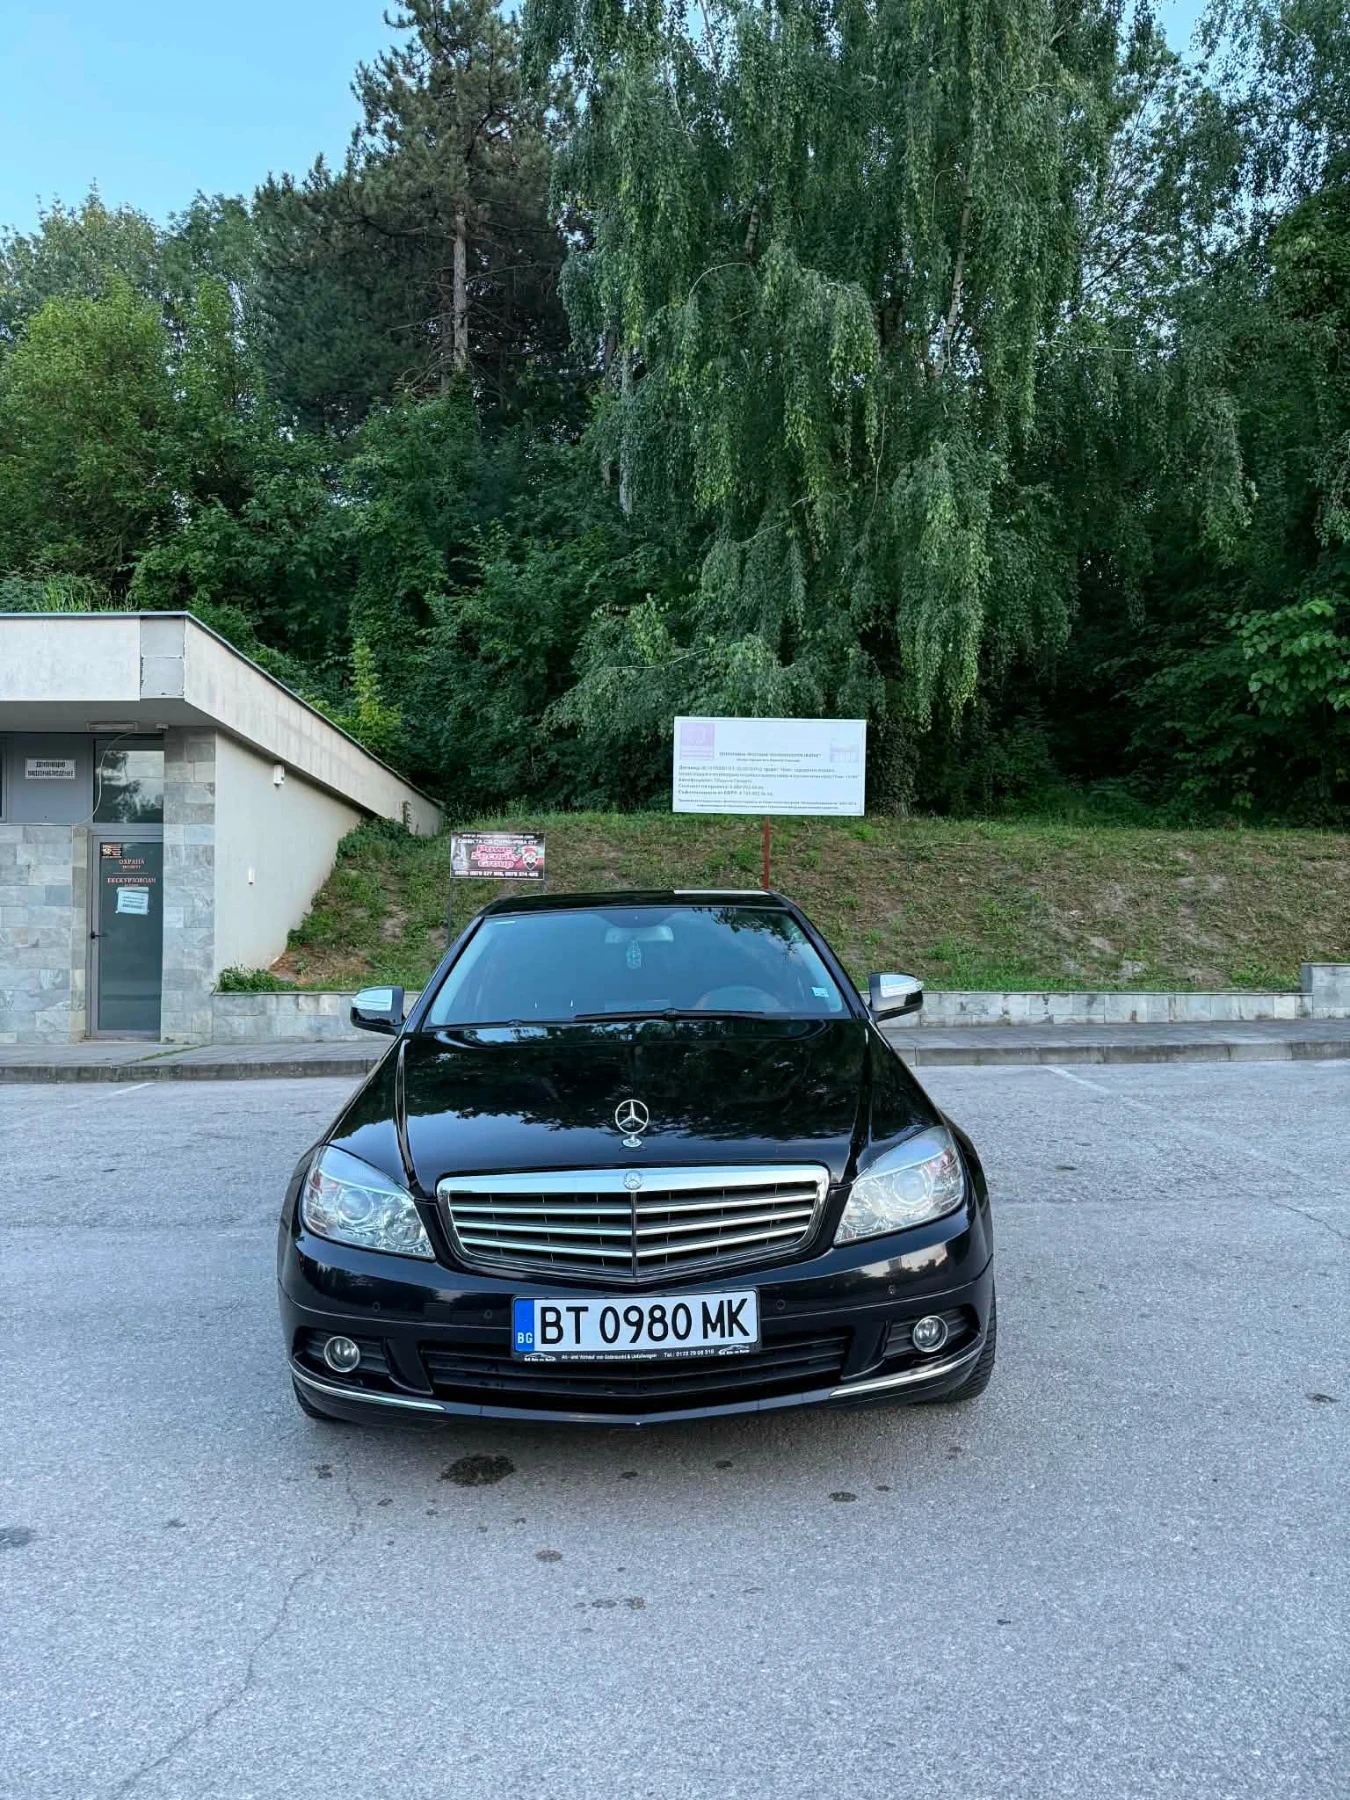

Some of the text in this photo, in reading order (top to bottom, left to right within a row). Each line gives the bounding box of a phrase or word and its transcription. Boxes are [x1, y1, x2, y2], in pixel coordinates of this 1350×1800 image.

[477, 845, 517, 854] Power
[471, 852, 521, 862] Security
[478, 860, 515, 869] Group
[540, 1298, 750, 1344] BT 0980 MK
[517, 1332, 533, 1344] BG
